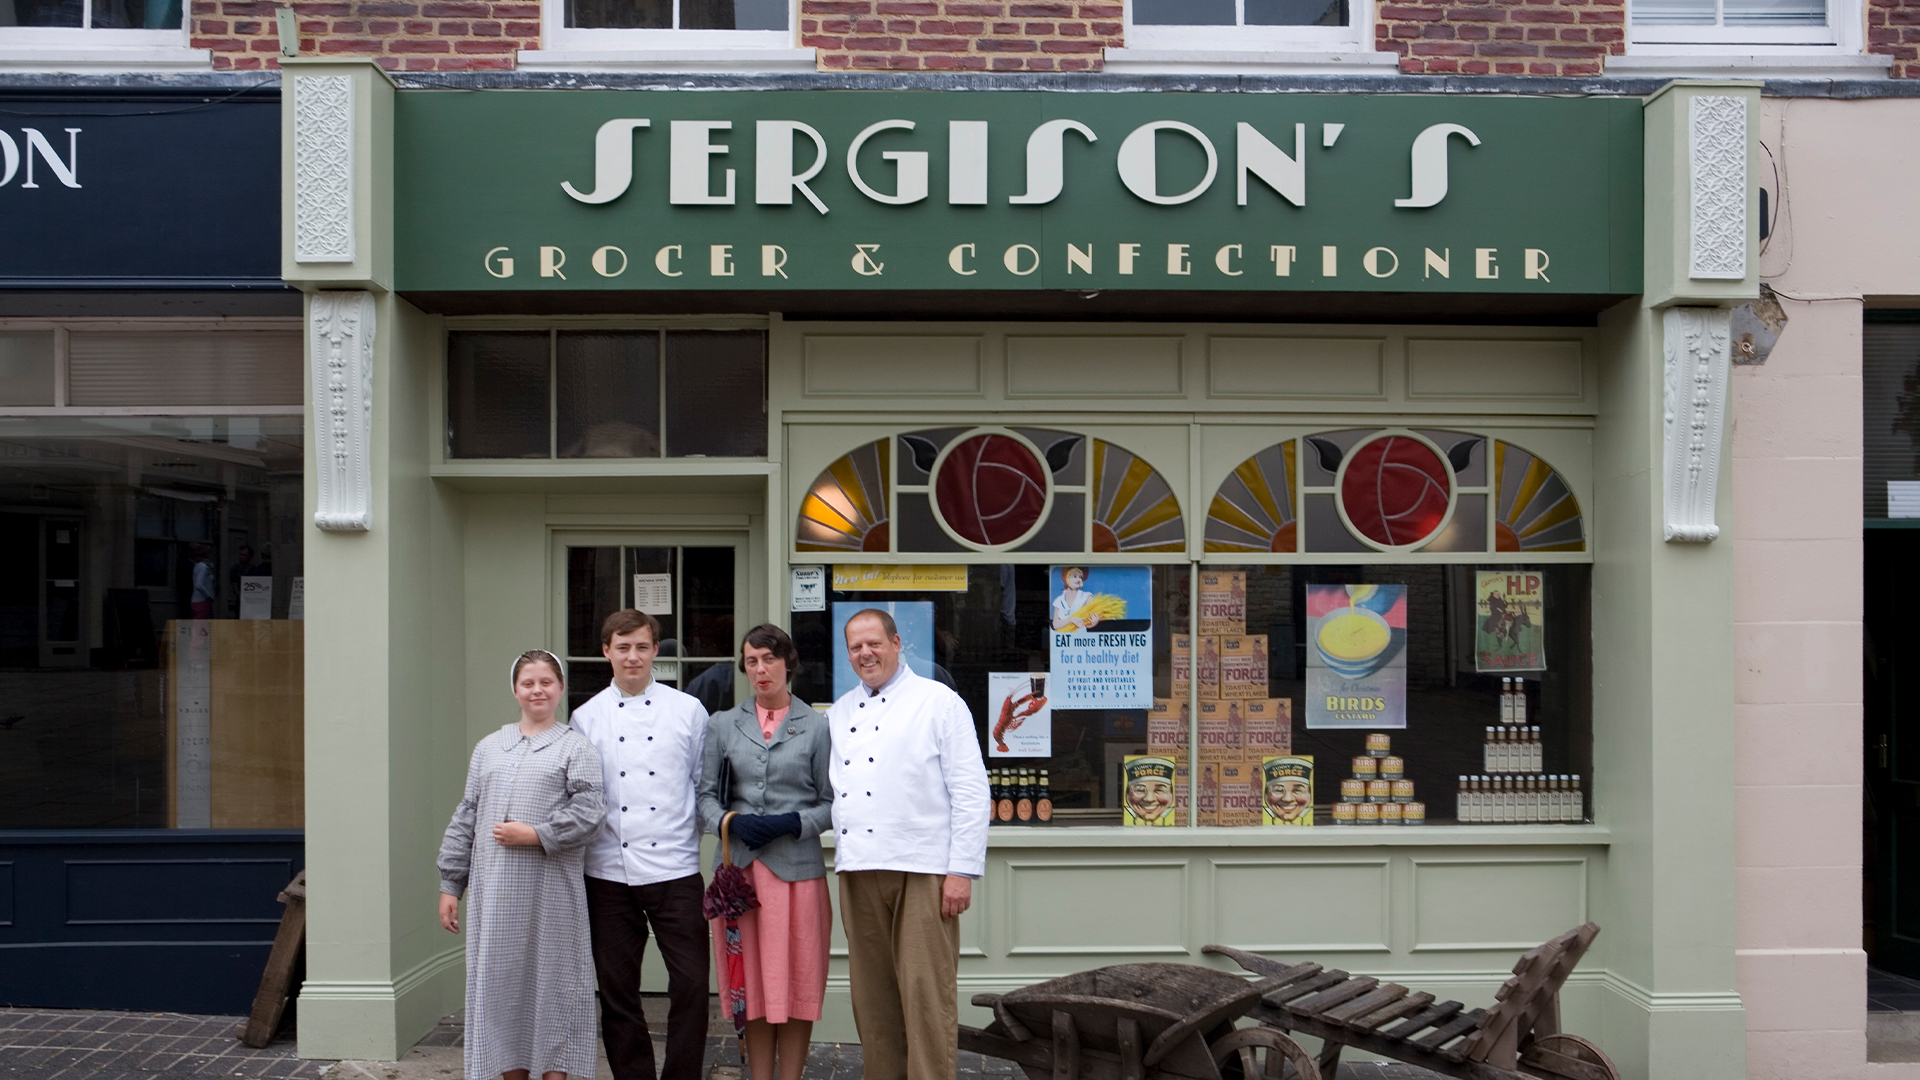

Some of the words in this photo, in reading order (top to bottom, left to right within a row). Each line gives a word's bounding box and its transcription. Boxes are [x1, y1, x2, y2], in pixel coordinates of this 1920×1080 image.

[560, 118, 1482, 215] SERGISON'S
[484, 244, 789, 280] GROCER
[851, 244, 885, 276] &
[948, 242, 1551, 283] CONFECTIONER
[913, 573, 923, 584] for
[925, 574, 952, 582] customer
[1203, 604, 1242, 617] FORCE
[1056, 634, 1071, 648] EAT
[1074, 638, 1096, 648] more
[1098, 634, 1126, 648] FRESH
[1129, 634, 1146, 647] VEG
[1060, 650, 1074, 664] for
[1076, 654, 1082, 664] a
[1086, 650, 1119, 666] healthy
[1122, 650, 1140, 664] diet
[1480, 651, 1540, 668] SAUCE
[652, 663, 676, 673] SED
[1226, 668, 1264, 680] FORCE
[1326, 696, 1386, 712] BIRD'S
[1201, 732, 1240, 744] FORCE
[1248, 732, 1288, 744] FORCE
[1176, 796, 1214, 807] FOCE
[1223, 796, 1262, 808] FORCE
